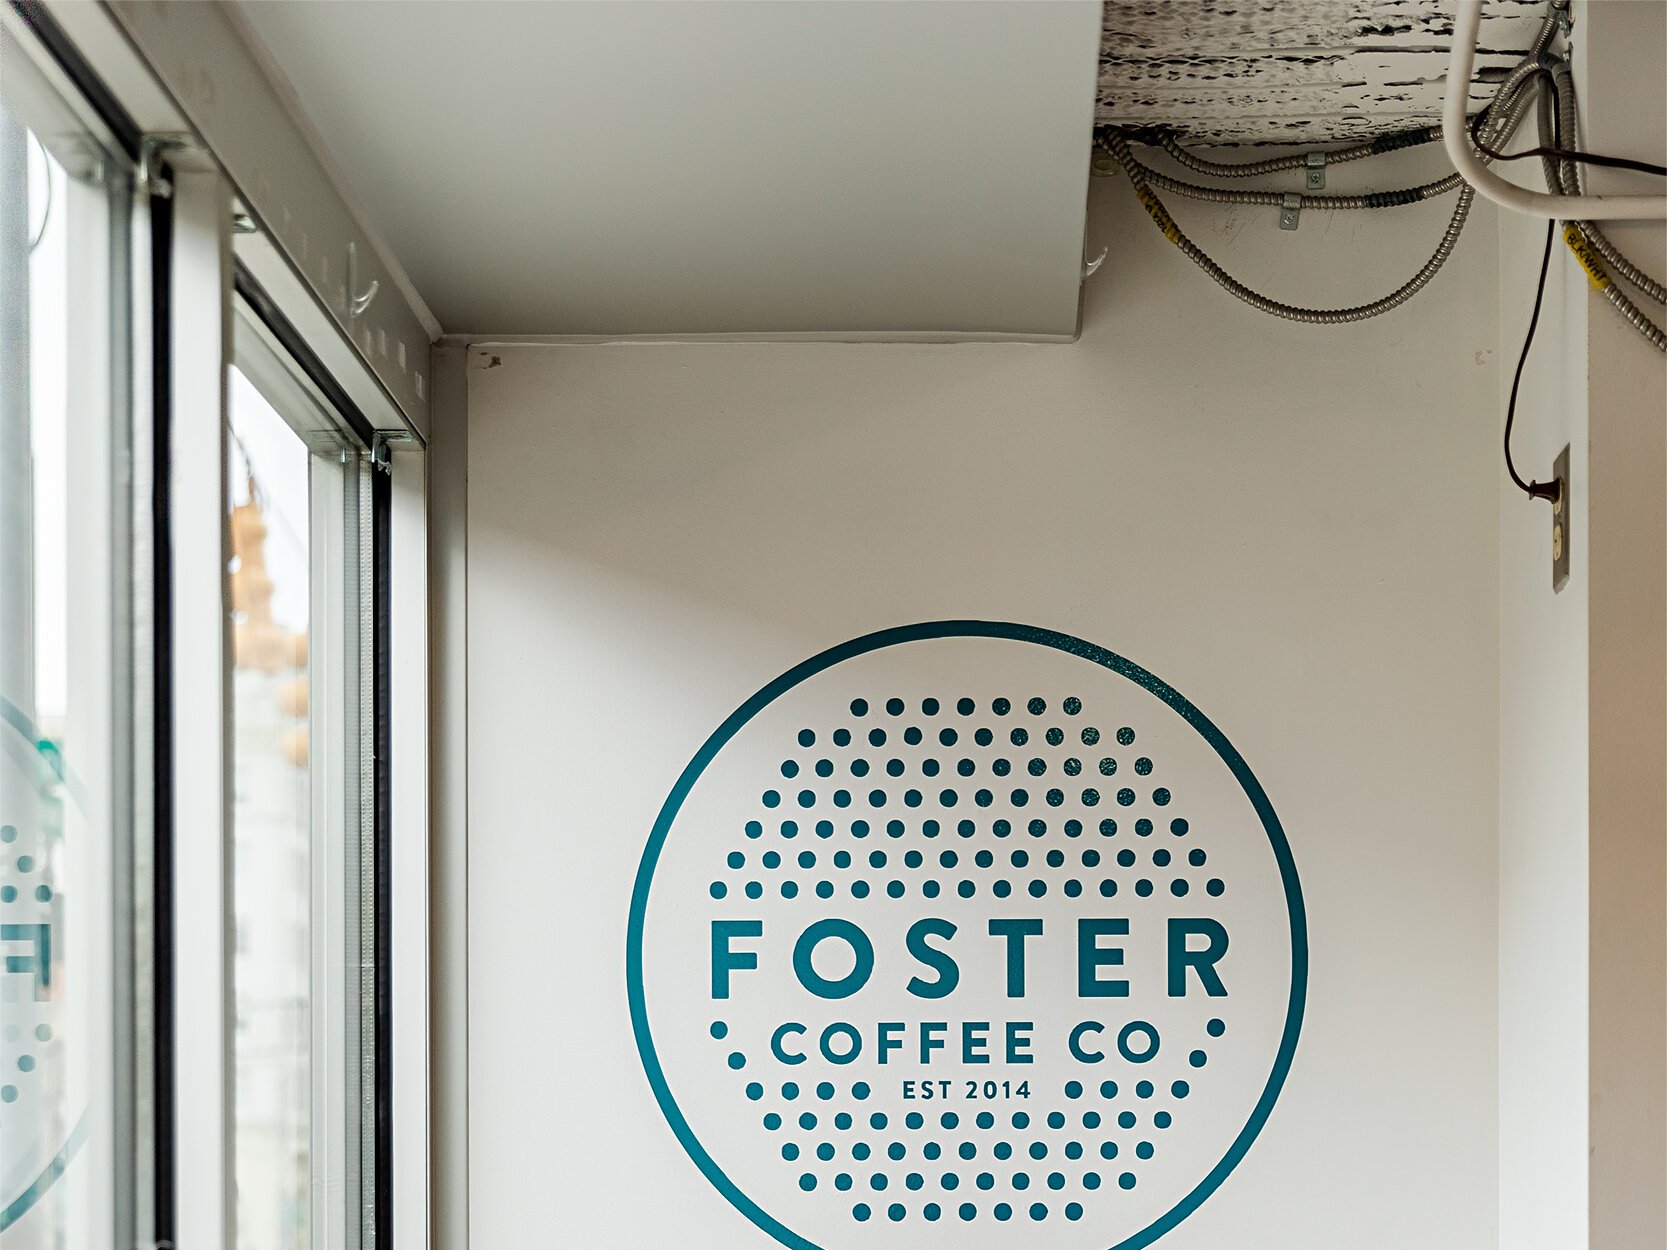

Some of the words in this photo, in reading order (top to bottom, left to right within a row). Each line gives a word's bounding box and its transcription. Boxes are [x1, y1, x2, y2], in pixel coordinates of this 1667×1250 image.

[1566, 232, 1607, 281] BLK/WHT
[710, 917, 1229, 1000] FOSTER
[770, 1021, 1034, 1066] COFFEE
[1067, 1020, 1161, 1064] CO
[903, 1080, 952, 1100] EST
[965, 1080, 1031, 1100] 2014
